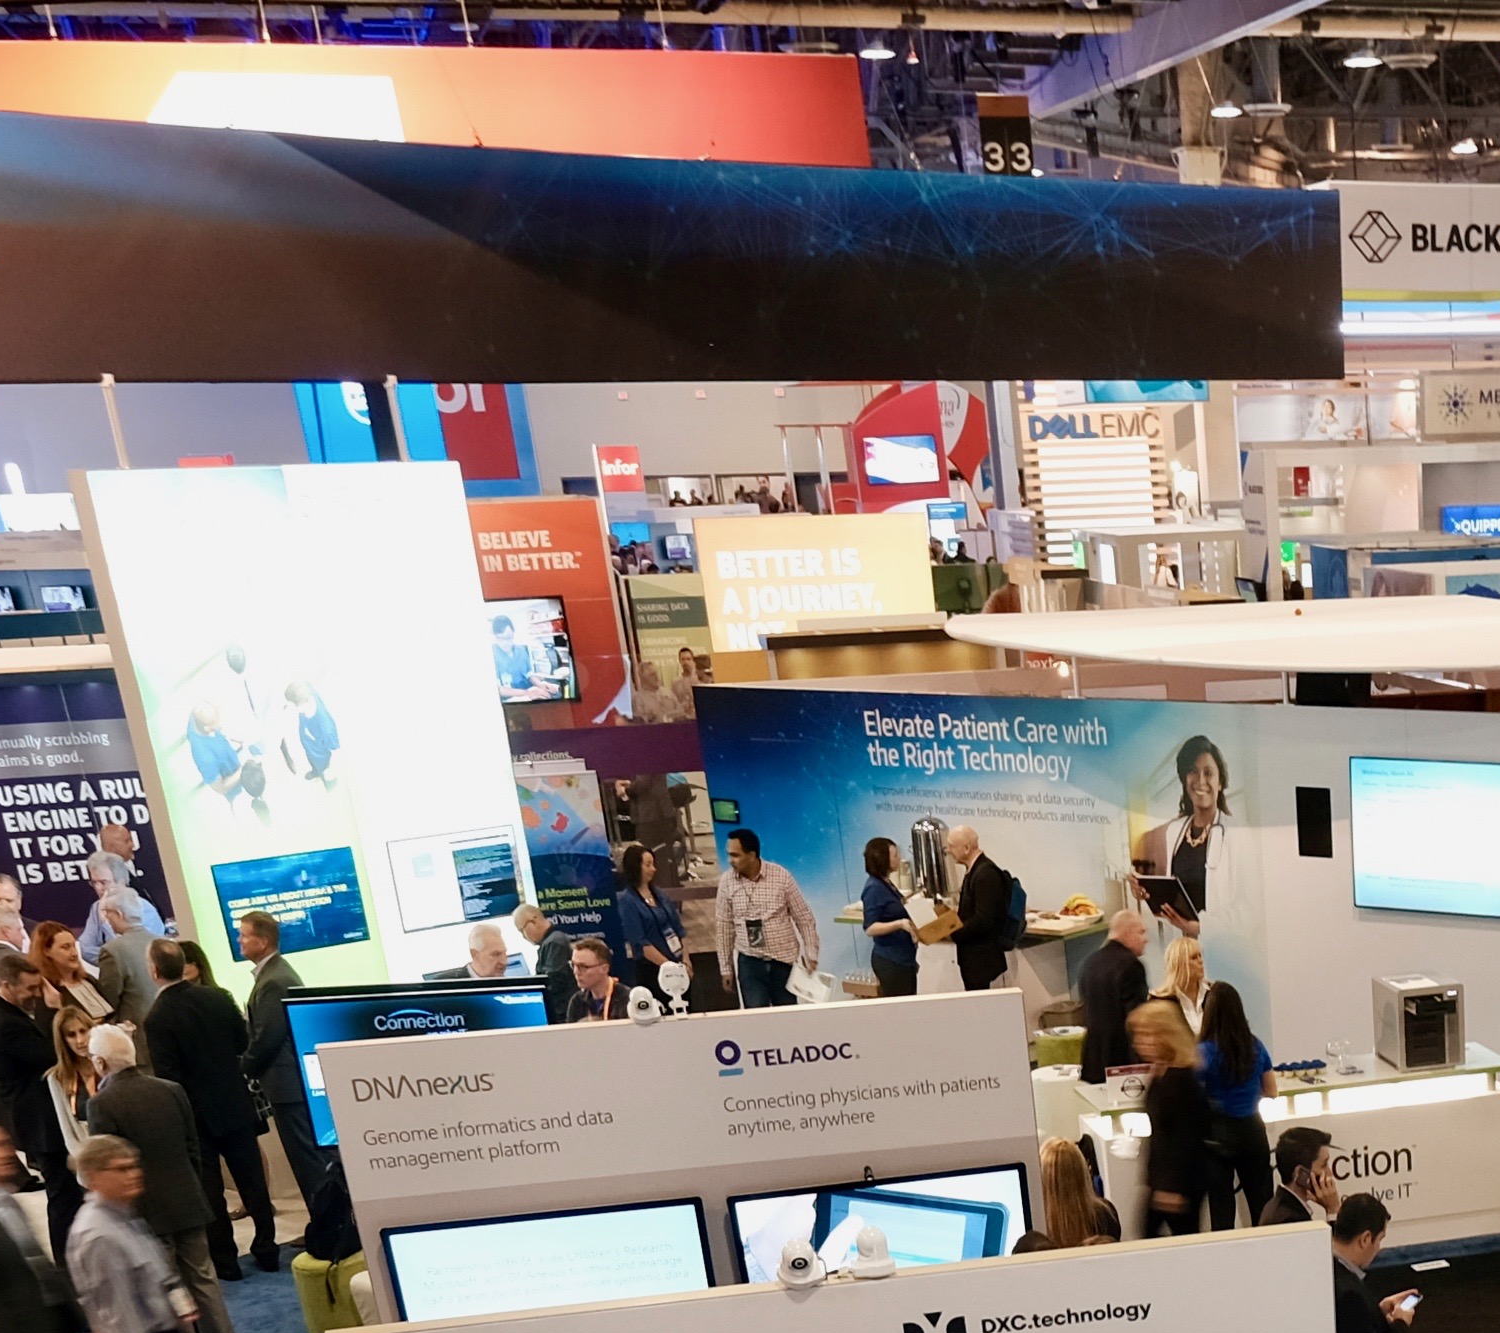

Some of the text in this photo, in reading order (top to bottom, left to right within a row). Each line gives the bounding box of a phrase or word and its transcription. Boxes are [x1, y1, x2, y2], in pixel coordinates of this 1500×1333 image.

[601, 458, 639, 476] infor
[478, 530, 552, 550] BELIEVE
[482, 552, 580, 573] IN BETTER.
[716, 547, 861, 578] BETTER IS
[722, 582, 883, 620] A JOURNEY,
[863, 709, 1108, 745] Elevate Patient Care with
[45, 731, 110, 748] scrubbing
[32, 753, 43, 766] is
[47, 751, 84, 768] good.
[867, 739, 1071, 781] the Right Technology
[79, 782, 98, 802] A
[2, 808, 128, 833] ENGINE TO
[9, 835, 82, 859] IT FOR
[17, 863, 44, 884] IS
[545, 887, 587, 898] Moment
[558, 897, 610, 910] Some Love
[559, 912, 602, 925] Your Help
[374, 1009, 466, 1031] Connection
[723, 1074, 1000, 1113] Connecting physicians with patients
[363, 1110, 614, 1145] Genome informatics and data
